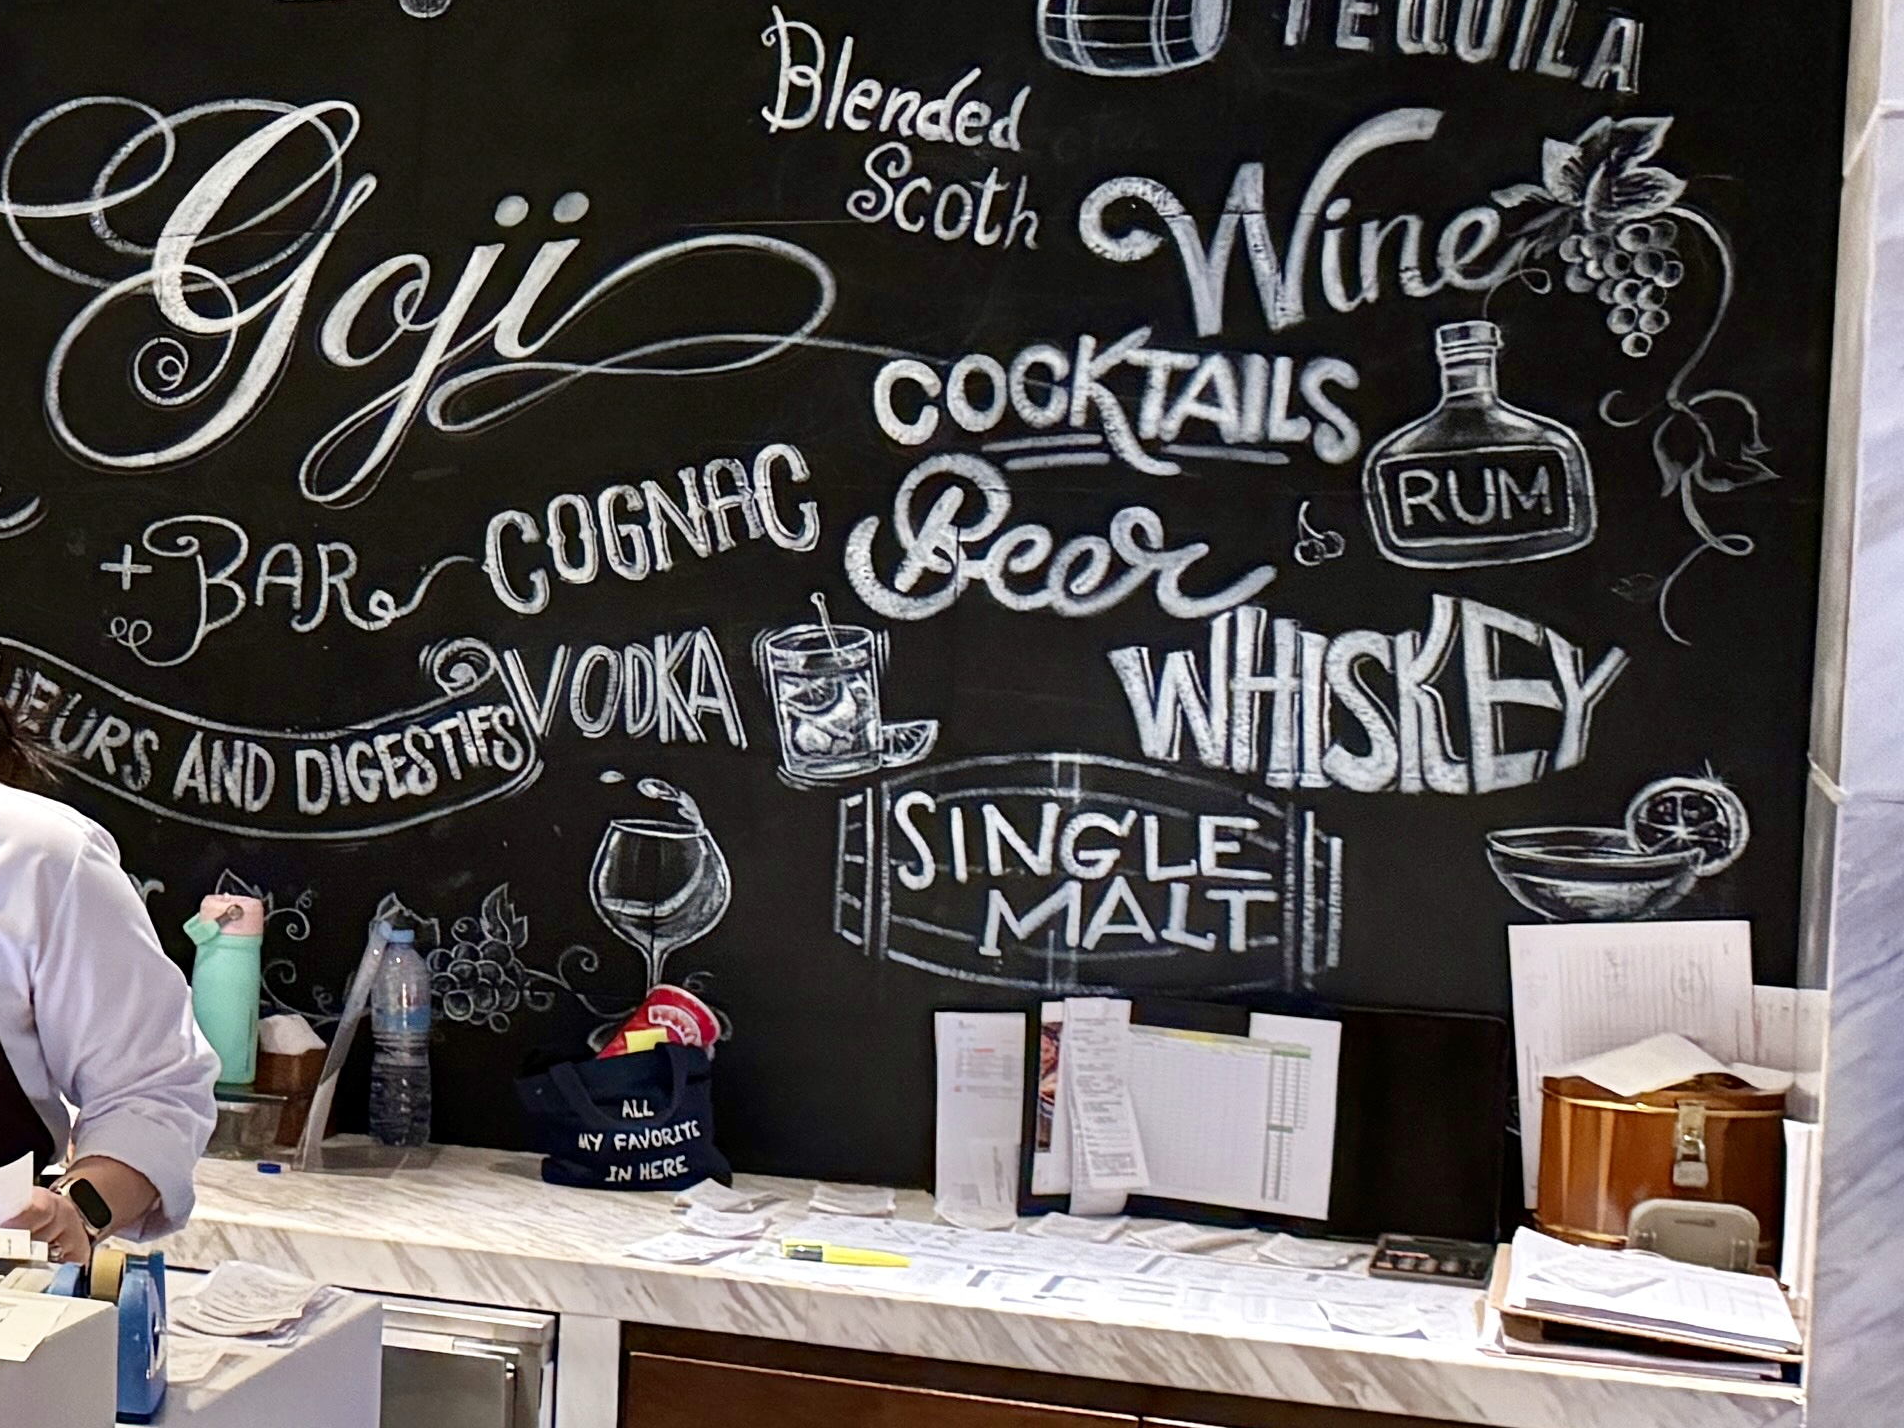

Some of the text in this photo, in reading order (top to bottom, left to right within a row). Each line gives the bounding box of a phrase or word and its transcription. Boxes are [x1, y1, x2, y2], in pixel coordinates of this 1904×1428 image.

[761, 5, 1034, 154] Blended
[1079, 107, 1522, 337] Wine
[873, 327, 1361, 475] COCKTAILS
[483, 444, 821, 616] COGNAC
[844, 452, 1278, 619] Beer
[1397, 465, 1554, 527] RUM
[106, 514, 407, 667] BAR
[504, 626, 748, 751] VODKA
[1109, 592, 1632, 795] WHISKEY
[171, 731, 277, 813] AND
[294, 701, 525, 815] DIGESTIFS
[894, 790, 1272, 890] SINGLE
[979, 875, 1280, 957] MALT
[578, 1119, 701, 1152] MY FAVORITE
[604, 1154, 690, 1182] IN HERE
[622, 1098, 655, 1119] ALL
